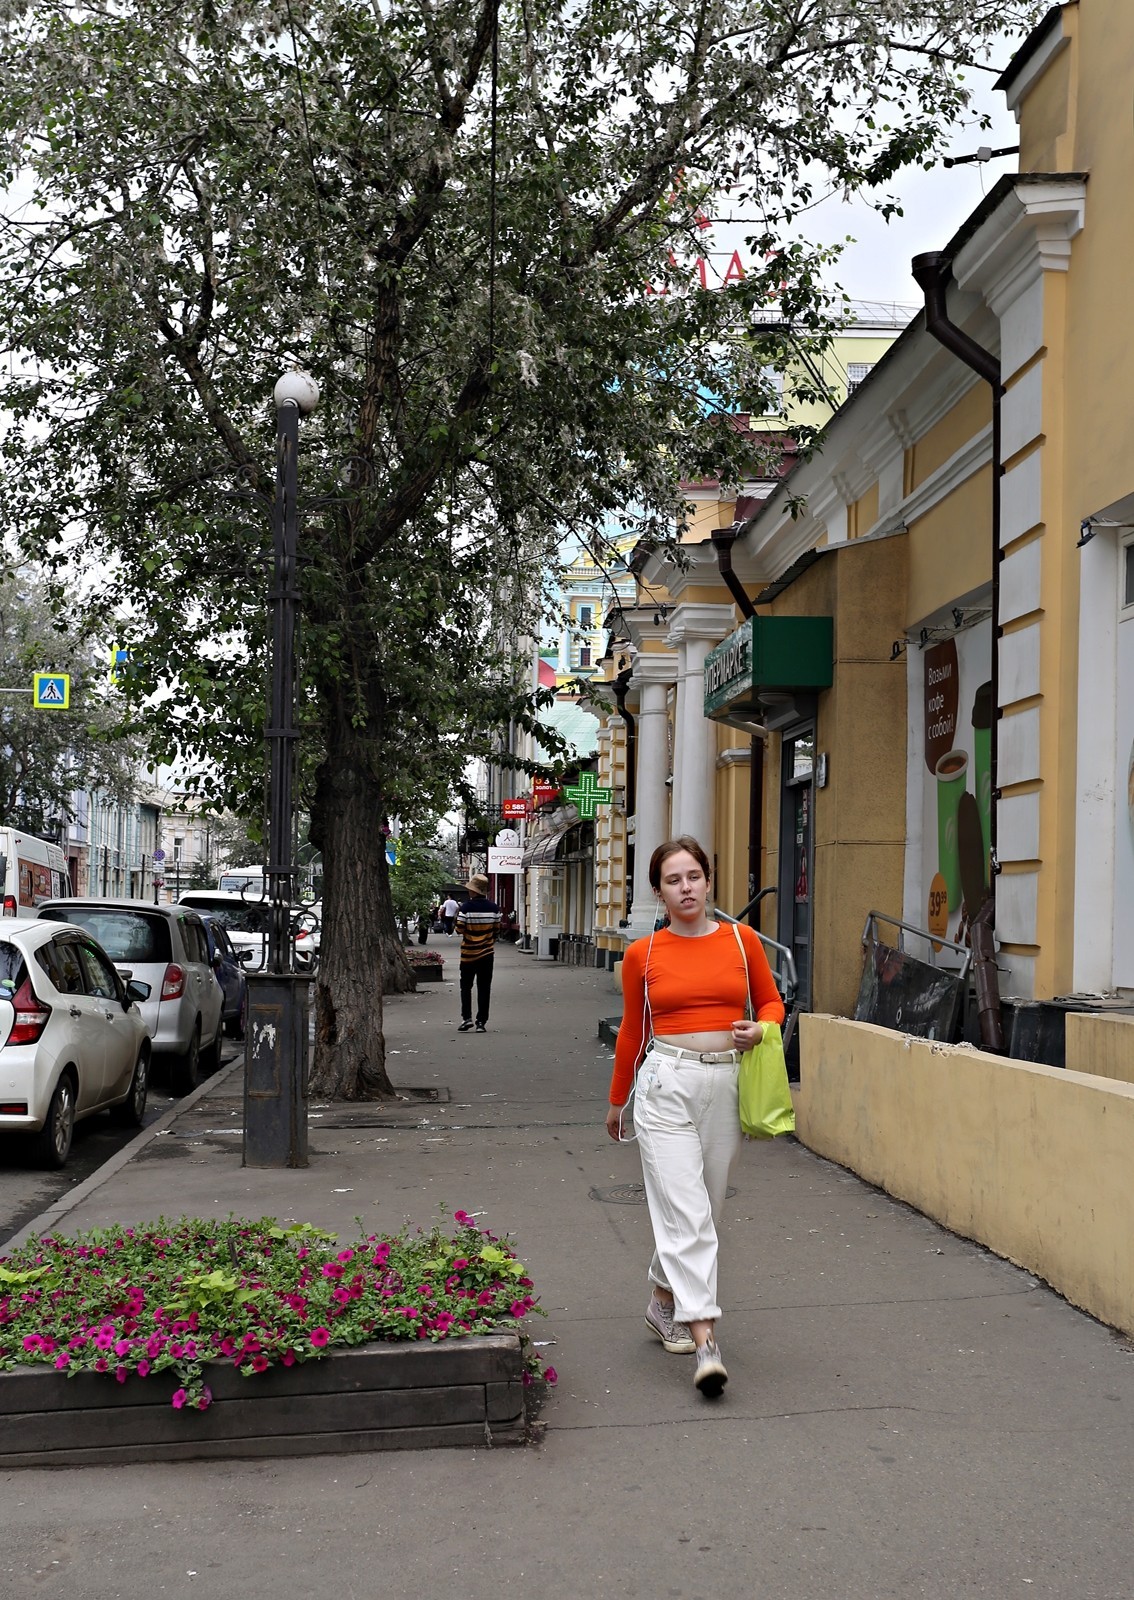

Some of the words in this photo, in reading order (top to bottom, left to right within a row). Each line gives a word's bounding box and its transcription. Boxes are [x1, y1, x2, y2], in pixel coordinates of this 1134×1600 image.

[705, 640, 752, 696] УПЕРМАРКЕТ
[928, 664, 952, 686] Возьми
[928, 692, 945, 714] кофе
[932, 713, 954, 739] собой!
